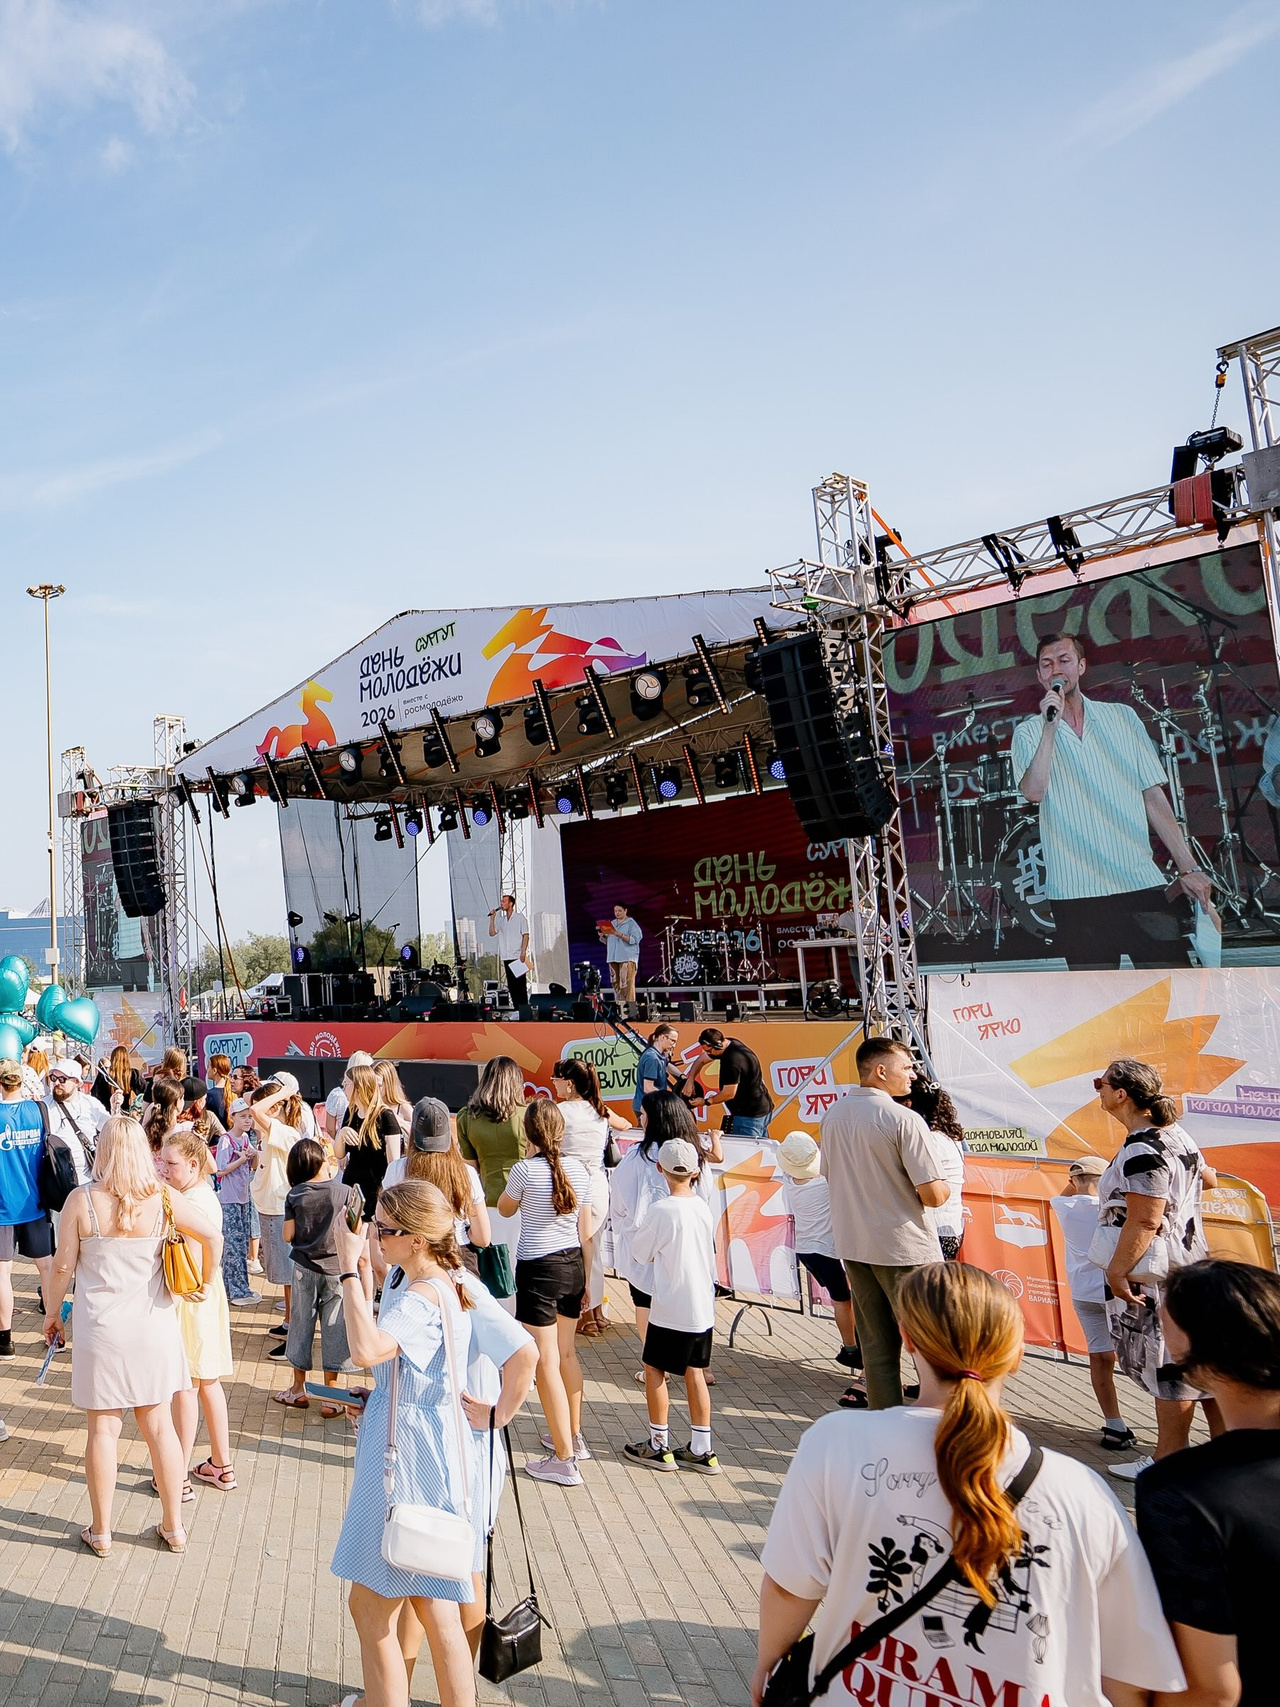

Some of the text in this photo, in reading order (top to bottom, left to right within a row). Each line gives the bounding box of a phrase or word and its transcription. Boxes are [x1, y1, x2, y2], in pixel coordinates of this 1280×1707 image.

[415, 621, 456, 653] СУРГУТ
[360, 652, 462, 703] МОЛОДЁЖИ
[361, 704, 396, 728] 2026
[404, 695, 464, 718] росмолодёжь
[933, 713, 1038, 753] вмест
[694, 871, 856, 921] МОЛОДЁЖ
[952, 1002, 993, 1023] ГОРИ
[977, 1017, 1021, 1041] ЯРКО
[777, 1065, 827, 1088] ГОРИ
[861, 1457, 938, 1498] Sorry
